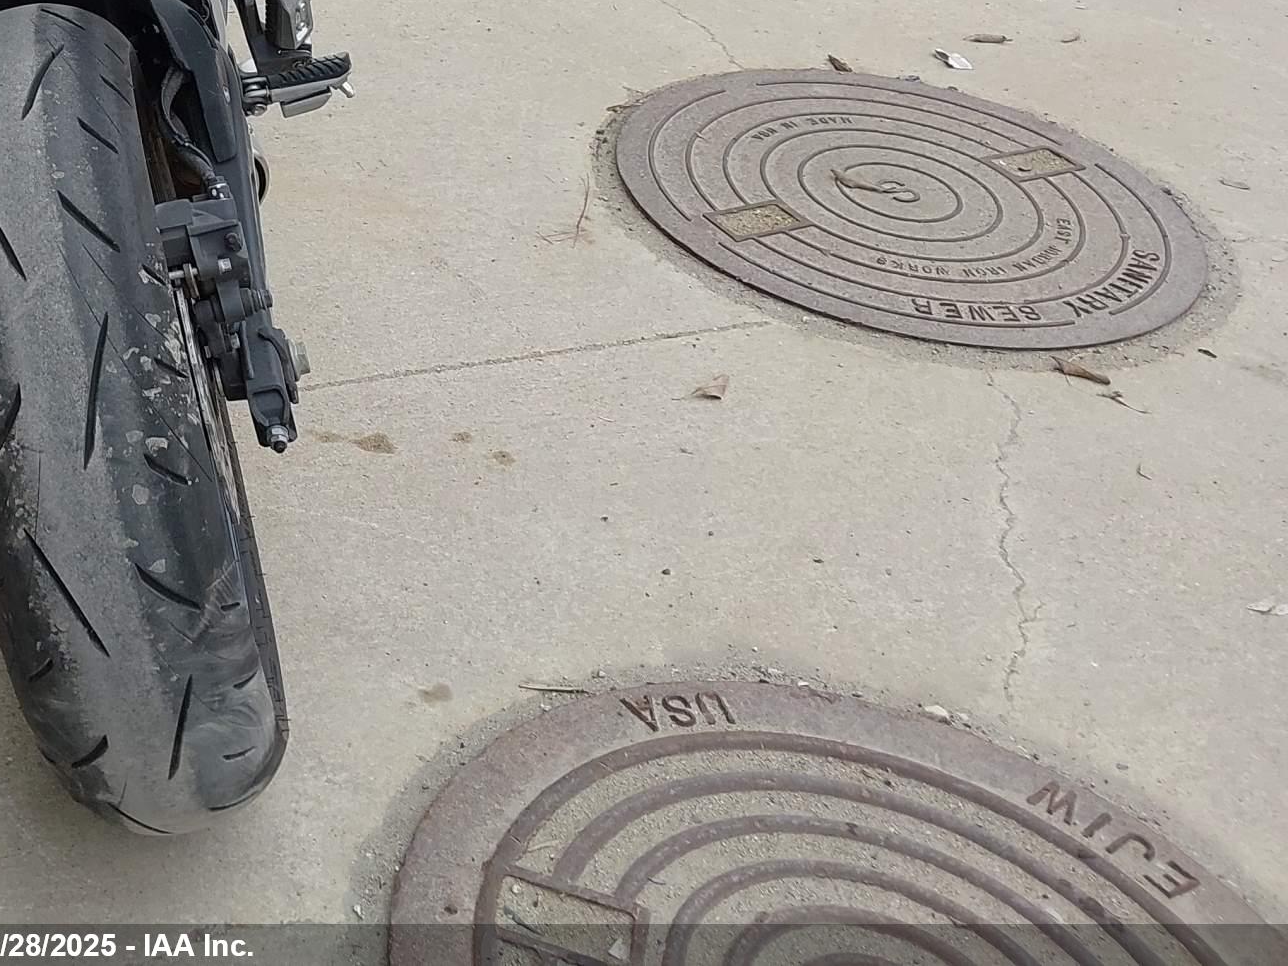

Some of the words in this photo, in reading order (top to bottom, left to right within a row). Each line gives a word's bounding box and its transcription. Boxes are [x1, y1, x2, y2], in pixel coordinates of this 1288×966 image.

[780, 121, 798, 131] IN
[806, 116, 853, 126] MADE
[1056, 218, 1071, 245] EAST
[876, 256, 951, 276] WORKS
[962, 265, 1008, 278] IRON
[1015, 245, 1062, 273] JORDAN
[1063, 249, 1161, 318] SANITARY
[912, 297, 1043, 322] SEWER
[619, 692, 736, 732] USA
[1026, 781, 1201, 899] EJIW
